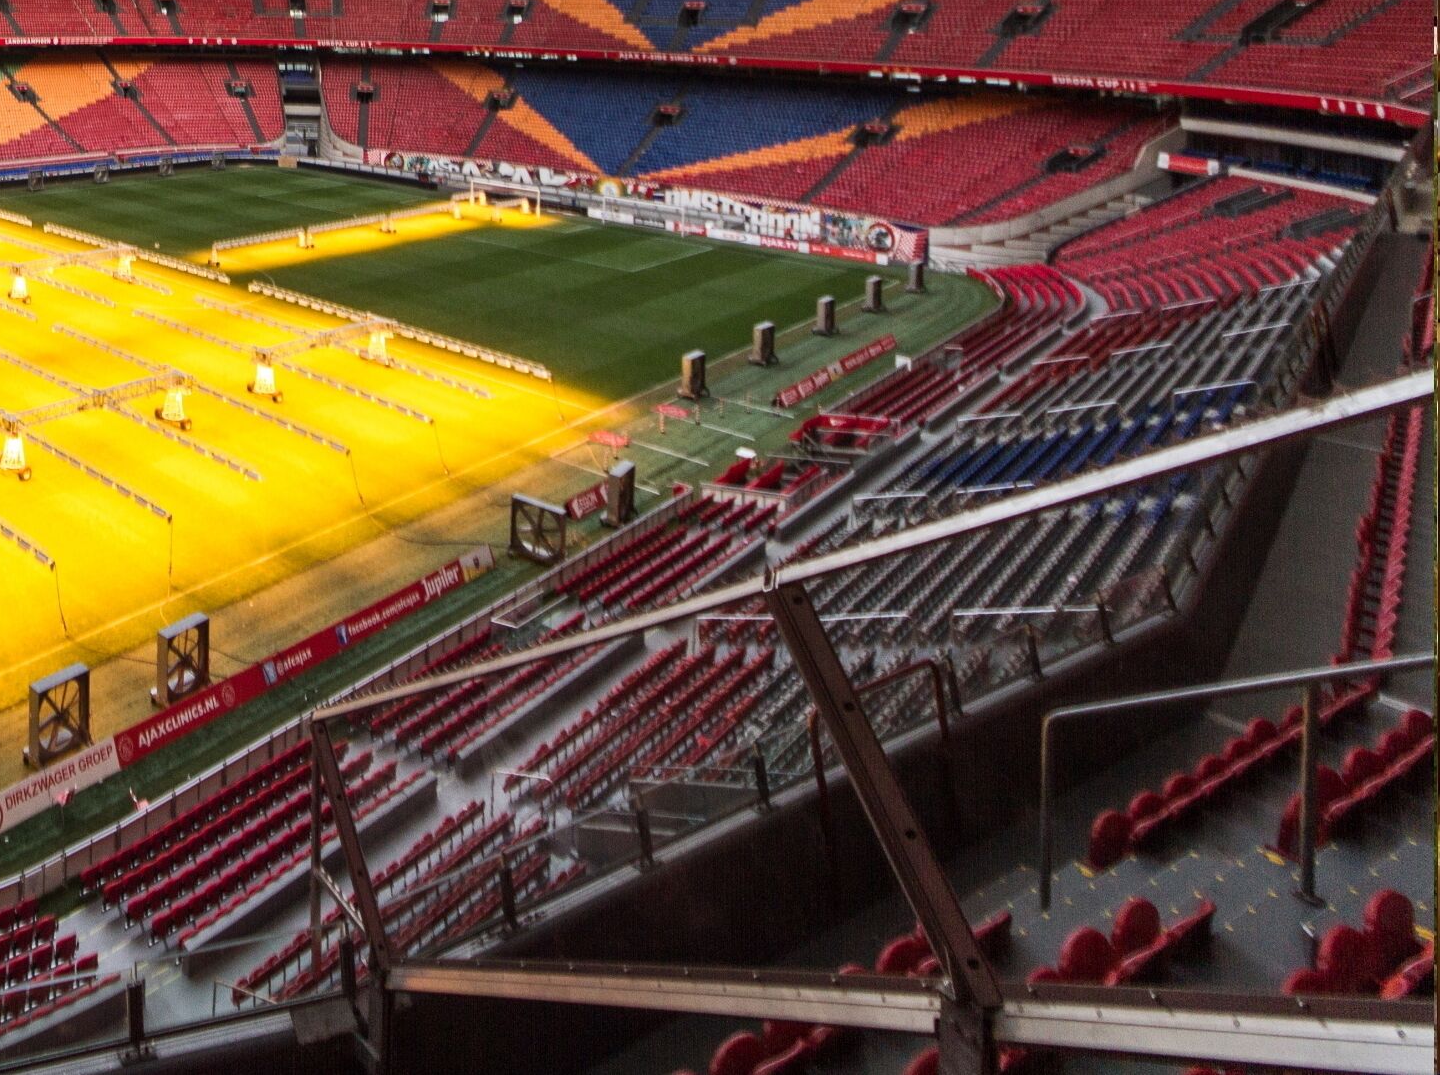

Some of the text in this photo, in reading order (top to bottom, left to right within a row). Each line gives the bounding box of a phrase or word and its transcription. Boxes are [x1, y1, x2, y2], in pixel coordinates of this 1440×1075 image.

[1052, 75, 1094, 87] EUROPA
[1097, 78, 1119, 89] CUP
[421, 564, 460, 602] Jupiler
[137, 695, 220, 748] AJAXCLINICS.NL
[4, 745, 113, 811] DIRKZWAGER GROEP
